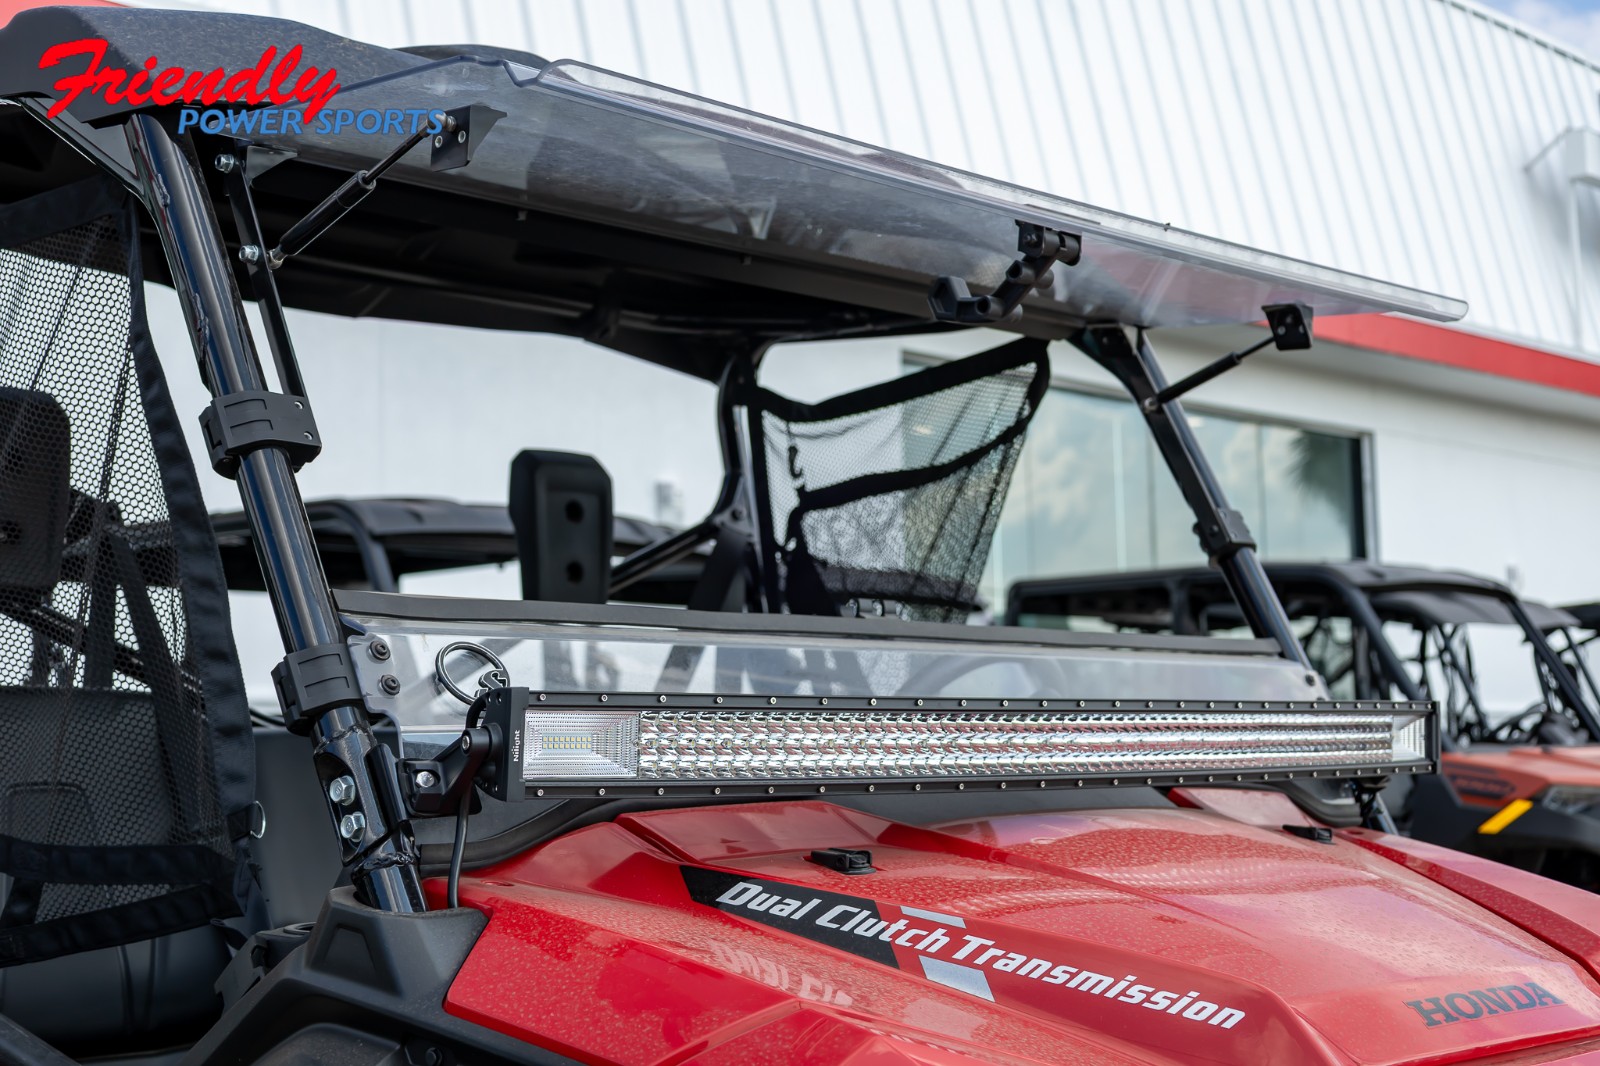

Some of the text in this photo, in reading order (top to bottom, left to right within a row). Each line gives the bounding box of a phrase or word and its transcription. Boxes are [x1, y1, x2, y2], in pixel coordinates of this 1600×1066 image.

[511, 729, 521, 762] Nilight
[716, 881, 1246, 1029] Dual Clutch Transmission
[1406, 982, 1565, 1027] HONDA
